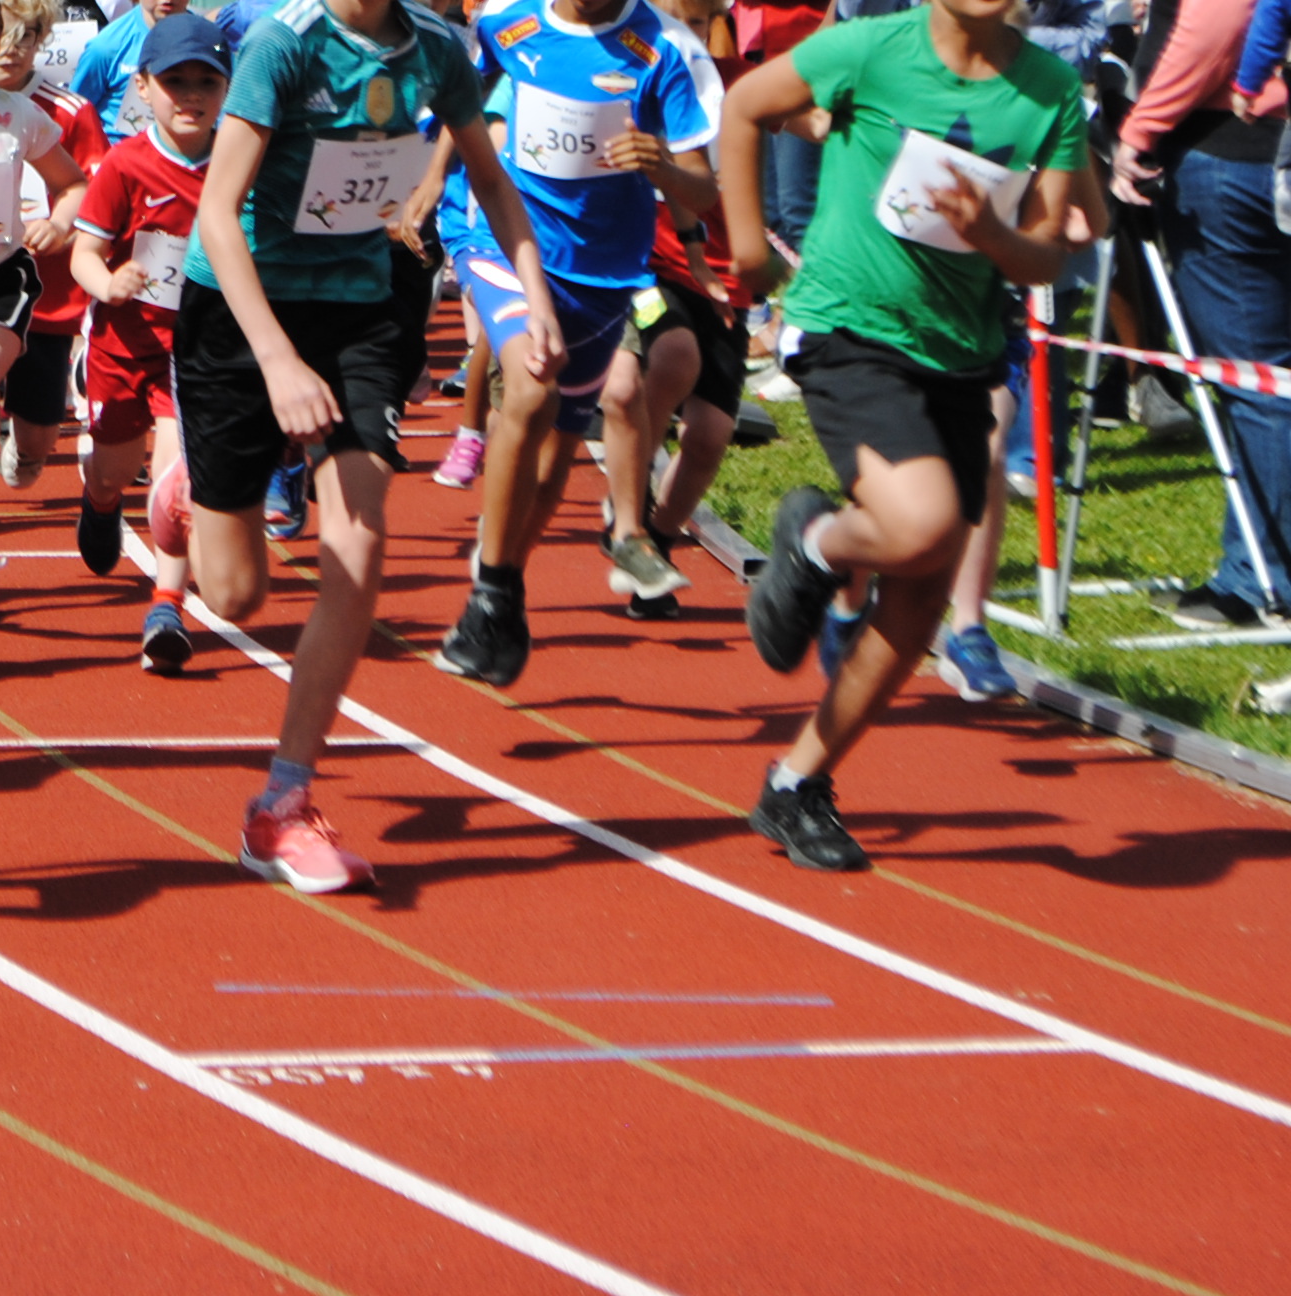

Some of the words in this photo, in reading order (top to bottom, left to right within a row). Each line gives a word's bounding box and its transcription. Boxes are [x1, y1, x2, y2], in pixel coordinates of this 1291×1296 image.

[44, 49, 68, 66] 28
[546, 128, 597, 154] 305
[339, 175, 389, 205] 327
